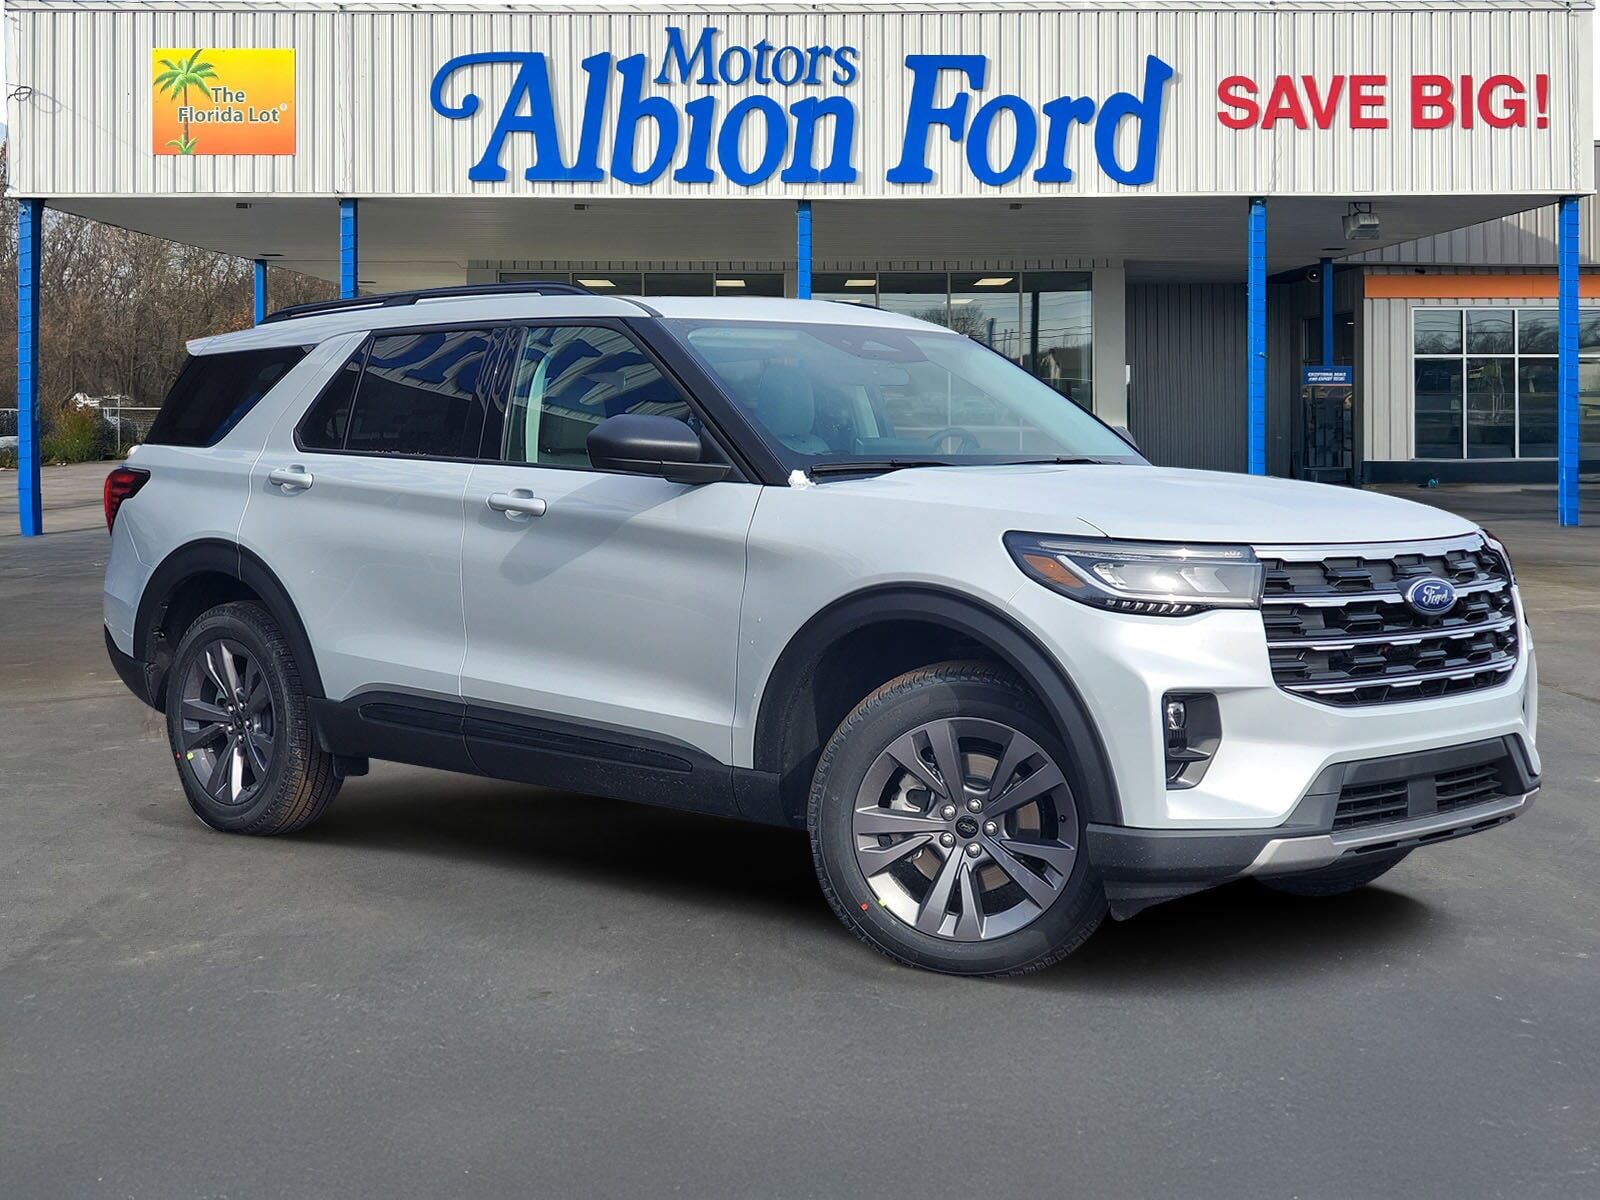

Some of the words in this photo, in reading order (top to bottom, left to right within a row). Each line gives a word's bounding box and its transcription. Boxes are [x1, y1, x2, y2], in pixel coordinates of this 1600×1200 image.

[653, 27, 858, 85] Motors
[210, 87, 246, 103] The
[1217, 74, 1388, 129] SAVE
[1411, 74, 1548, 129] BIG!
[178, 107, 244, 122] Florida
[248, 107, 279, 122] Lot
[430, 51, 857, 186] Albion
[886, 54, 1174, 186] Ford
[1422, 584, 1450, 606] Ford
